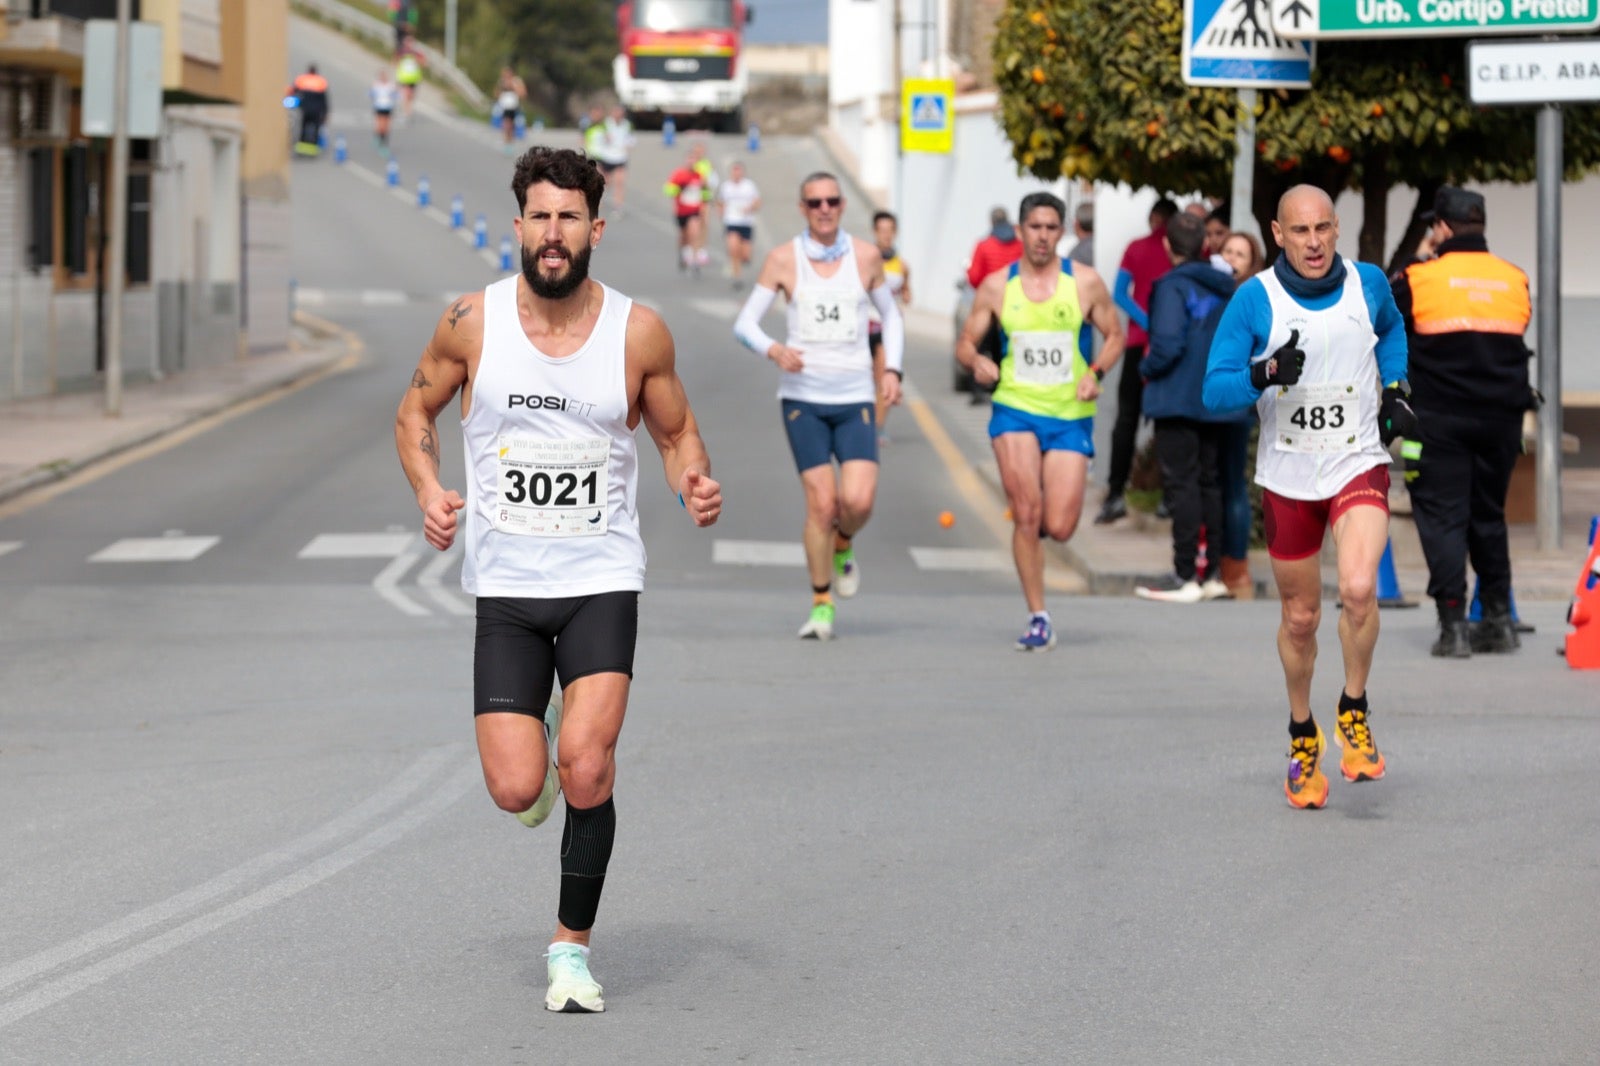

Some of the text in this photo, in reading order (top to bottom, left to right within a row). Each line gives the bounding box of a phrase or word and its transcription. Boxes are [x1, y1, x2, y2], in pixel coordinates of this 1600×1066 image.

[1356, 0, 1589, 25] Urb. Cortijo Pretel
[1557, 61, 1600, 79] ABA
[816, 304, 839, 322] 34
[1023, 348, 1062, 367] 630
[508, 394, 597, 417] POSIFIT
[1290, 404, 1345, 431] 483
[505, 469, 597, 506] 3021
